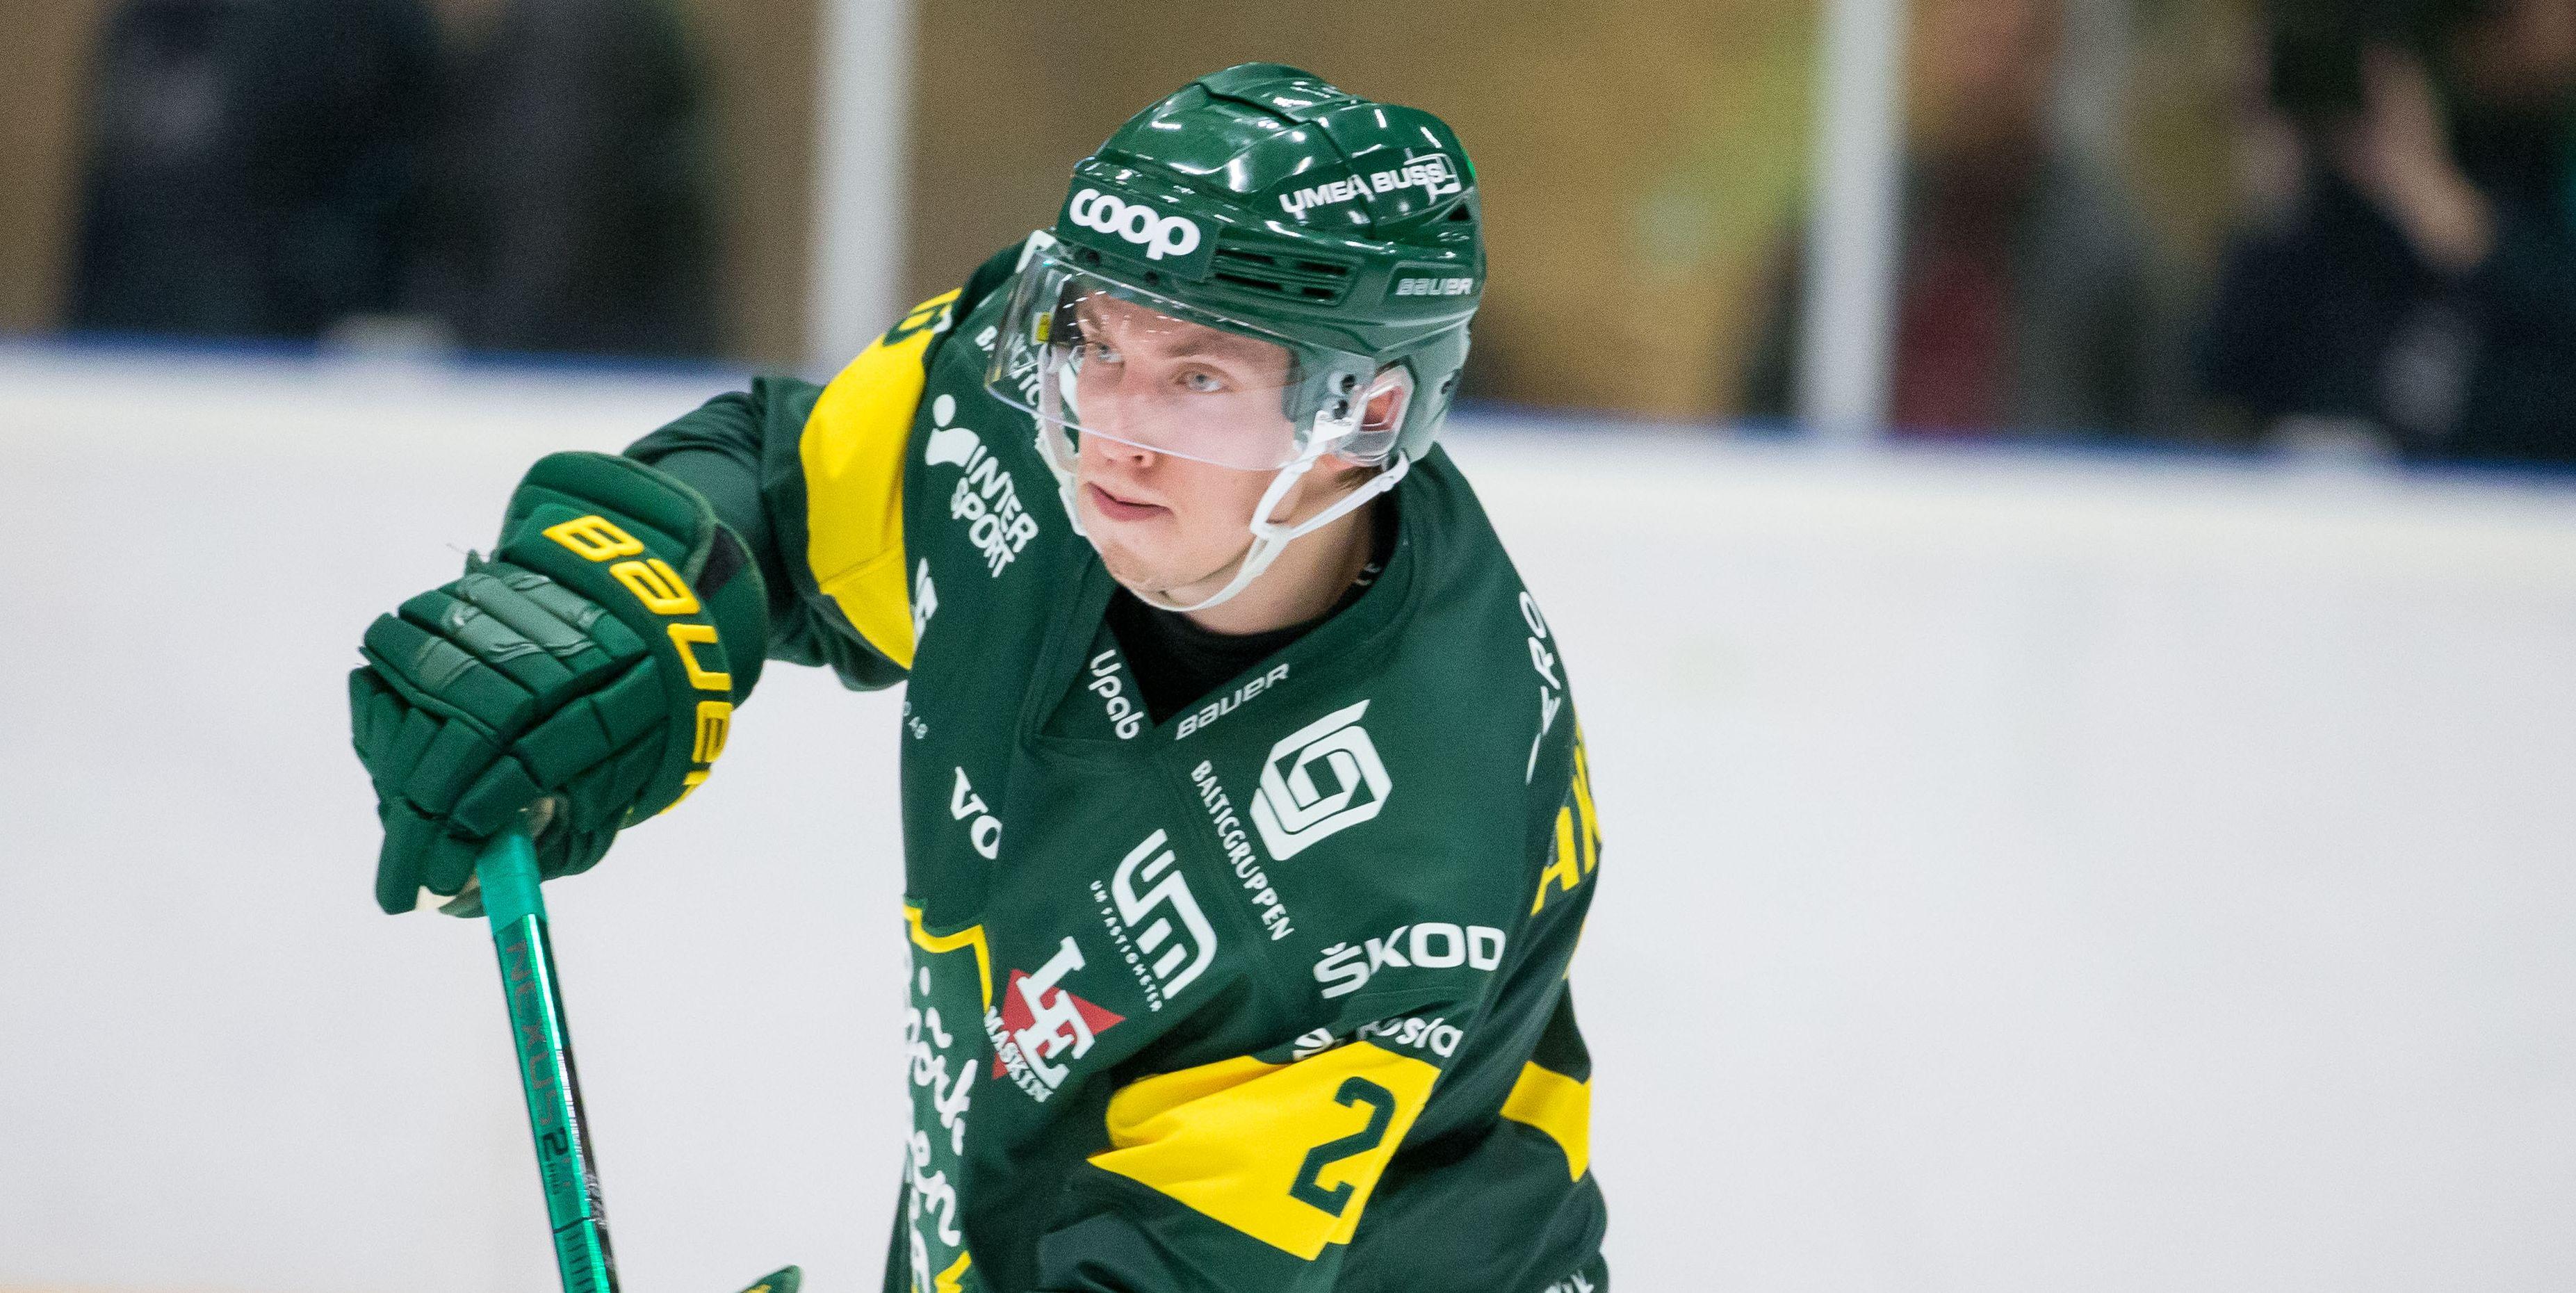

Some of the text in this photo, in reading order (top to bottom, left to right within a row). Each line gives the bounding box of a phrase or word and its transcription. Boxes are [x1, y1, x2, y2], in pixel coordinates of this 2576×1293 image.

[1069, 188, 1200, 260] coop
[1371, 163, 1446, 193] BUSS
[1395, 277, 1473, 295] BAUER
[965, 445, 1038, 553] INTER
[1088, 649, 1144, 740] Upab
[1175, 663, 1290, 740] BAUER
[1191, 761, 1294, 941] BALTICGRUPPEN
[506, 940, 557, 1126] NEXUS
[1013, 936, 1095, 1089] LE
[1288, 1076, 1396, 1218] 2
